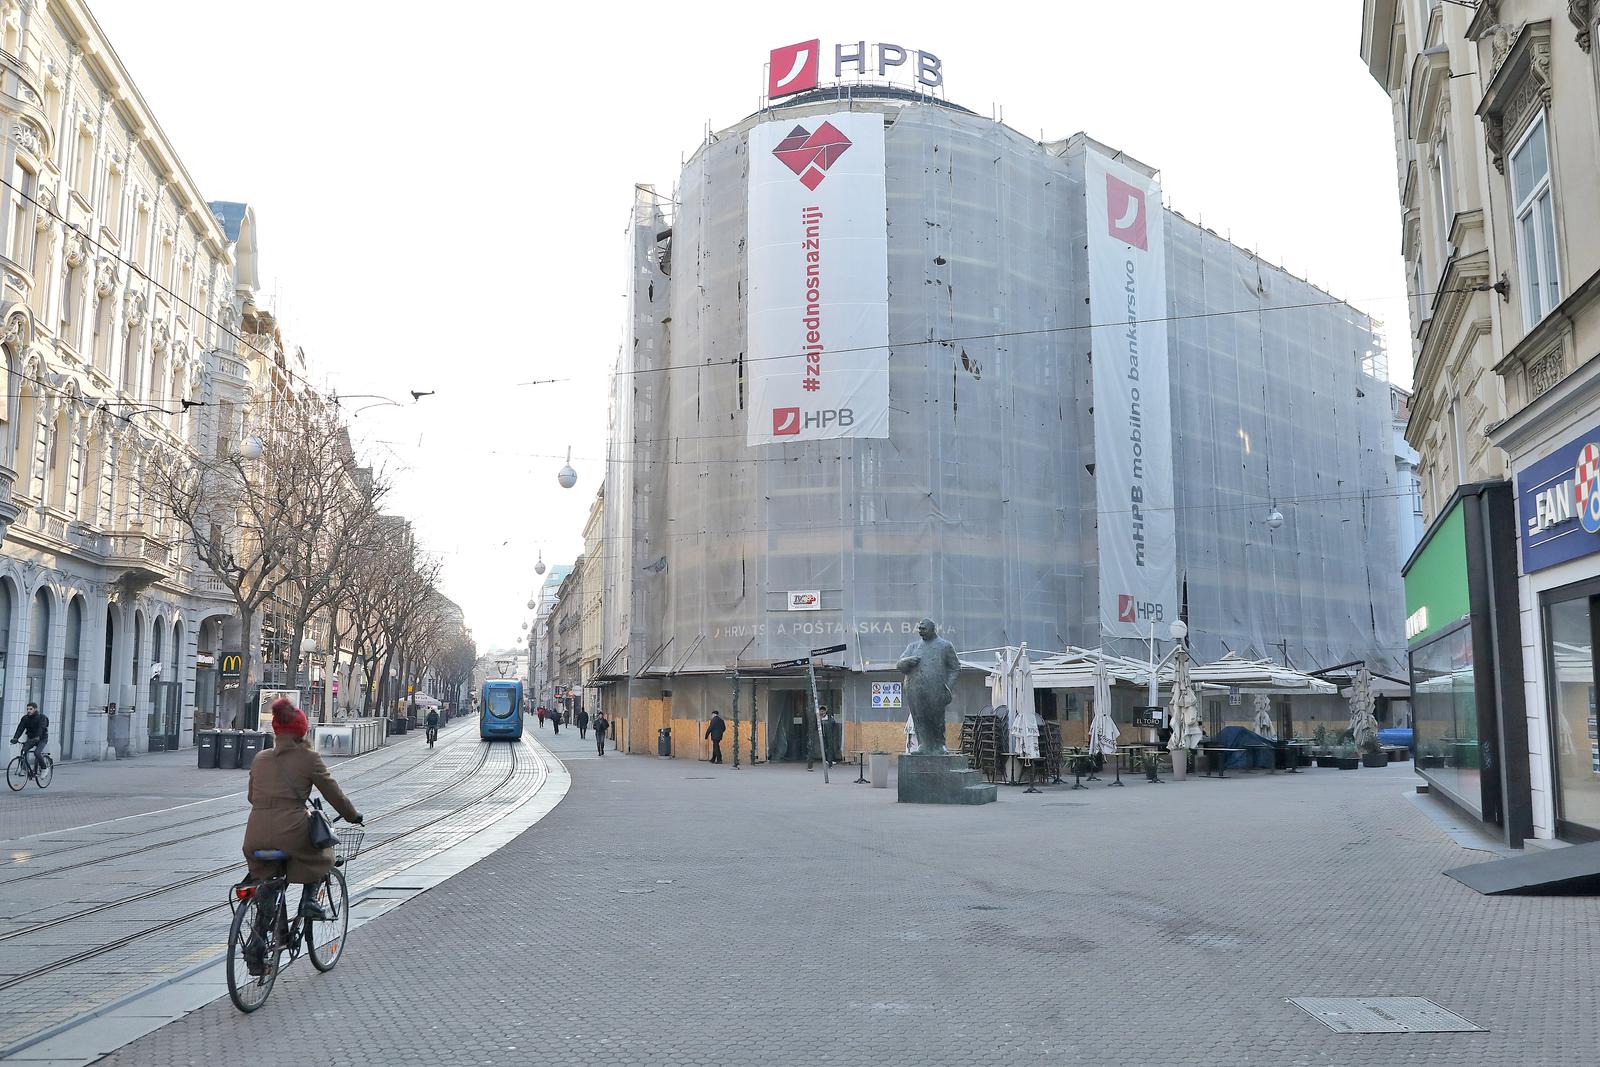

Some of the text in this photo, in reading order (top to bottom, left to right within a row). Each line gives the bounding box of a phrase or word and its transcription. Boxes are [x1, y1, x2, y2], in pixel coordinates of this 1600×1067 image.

[835, 40, 943, 88] HPB
[802, 206, 824, 392] #zajednosnažniji
[803, 408, 855, 430] HPB
[1123, 259, 1145, 567] mHPB mobilno bankarstvo
[1535, 479, 1573, 530] FAN
[1136, 601, 1164, 621] HPB
